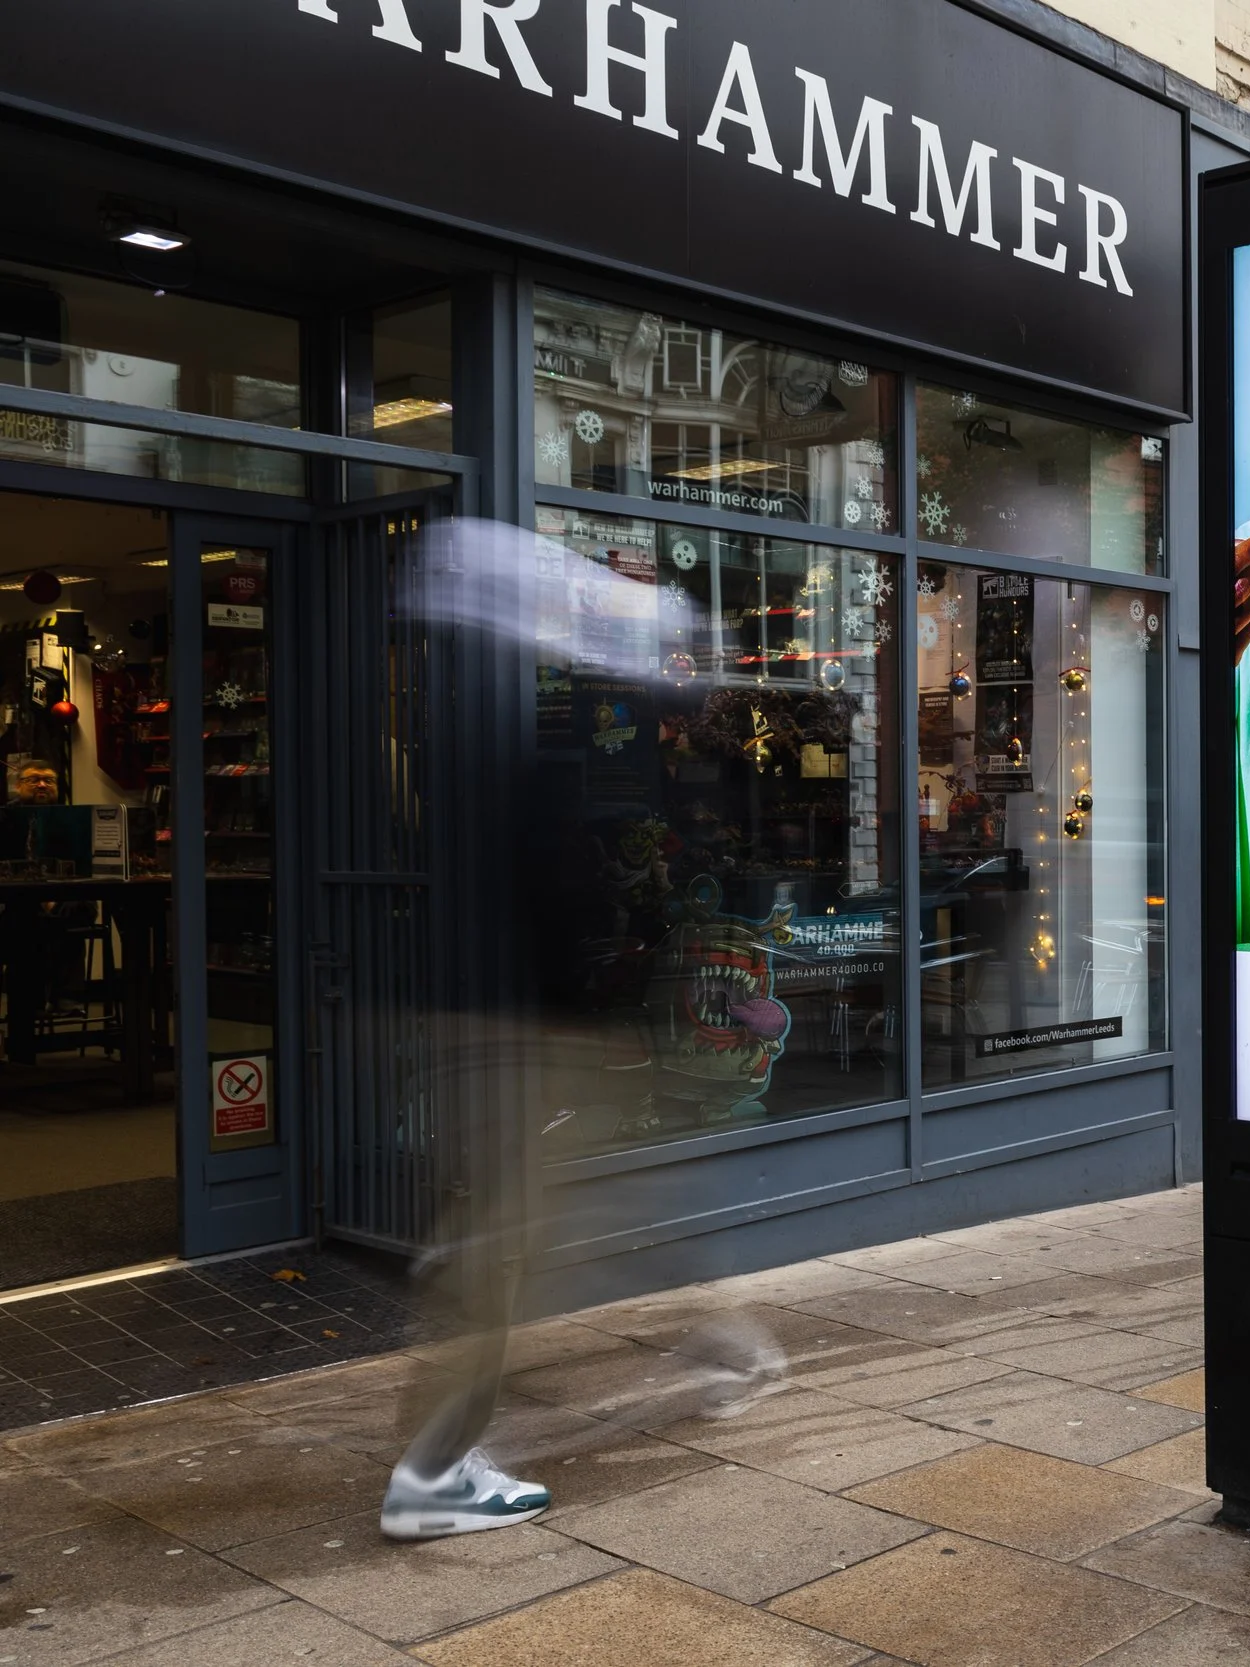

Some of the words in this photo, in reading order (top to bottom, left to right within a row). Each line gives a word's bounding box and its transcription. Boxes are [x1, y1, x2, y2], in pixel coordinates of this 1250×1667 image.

[298, 0, 1133, 297] RHAMMER
[647, 481, 783, 513] warhammer.com
[229, 577, 256, 589] PRS
[999, 585, 1029, 598] HONOURS
[792, 921, 883, 945] ARHAMME
[995, 1023, 1115, 1049] facebook.com/WarhammerLeeds
